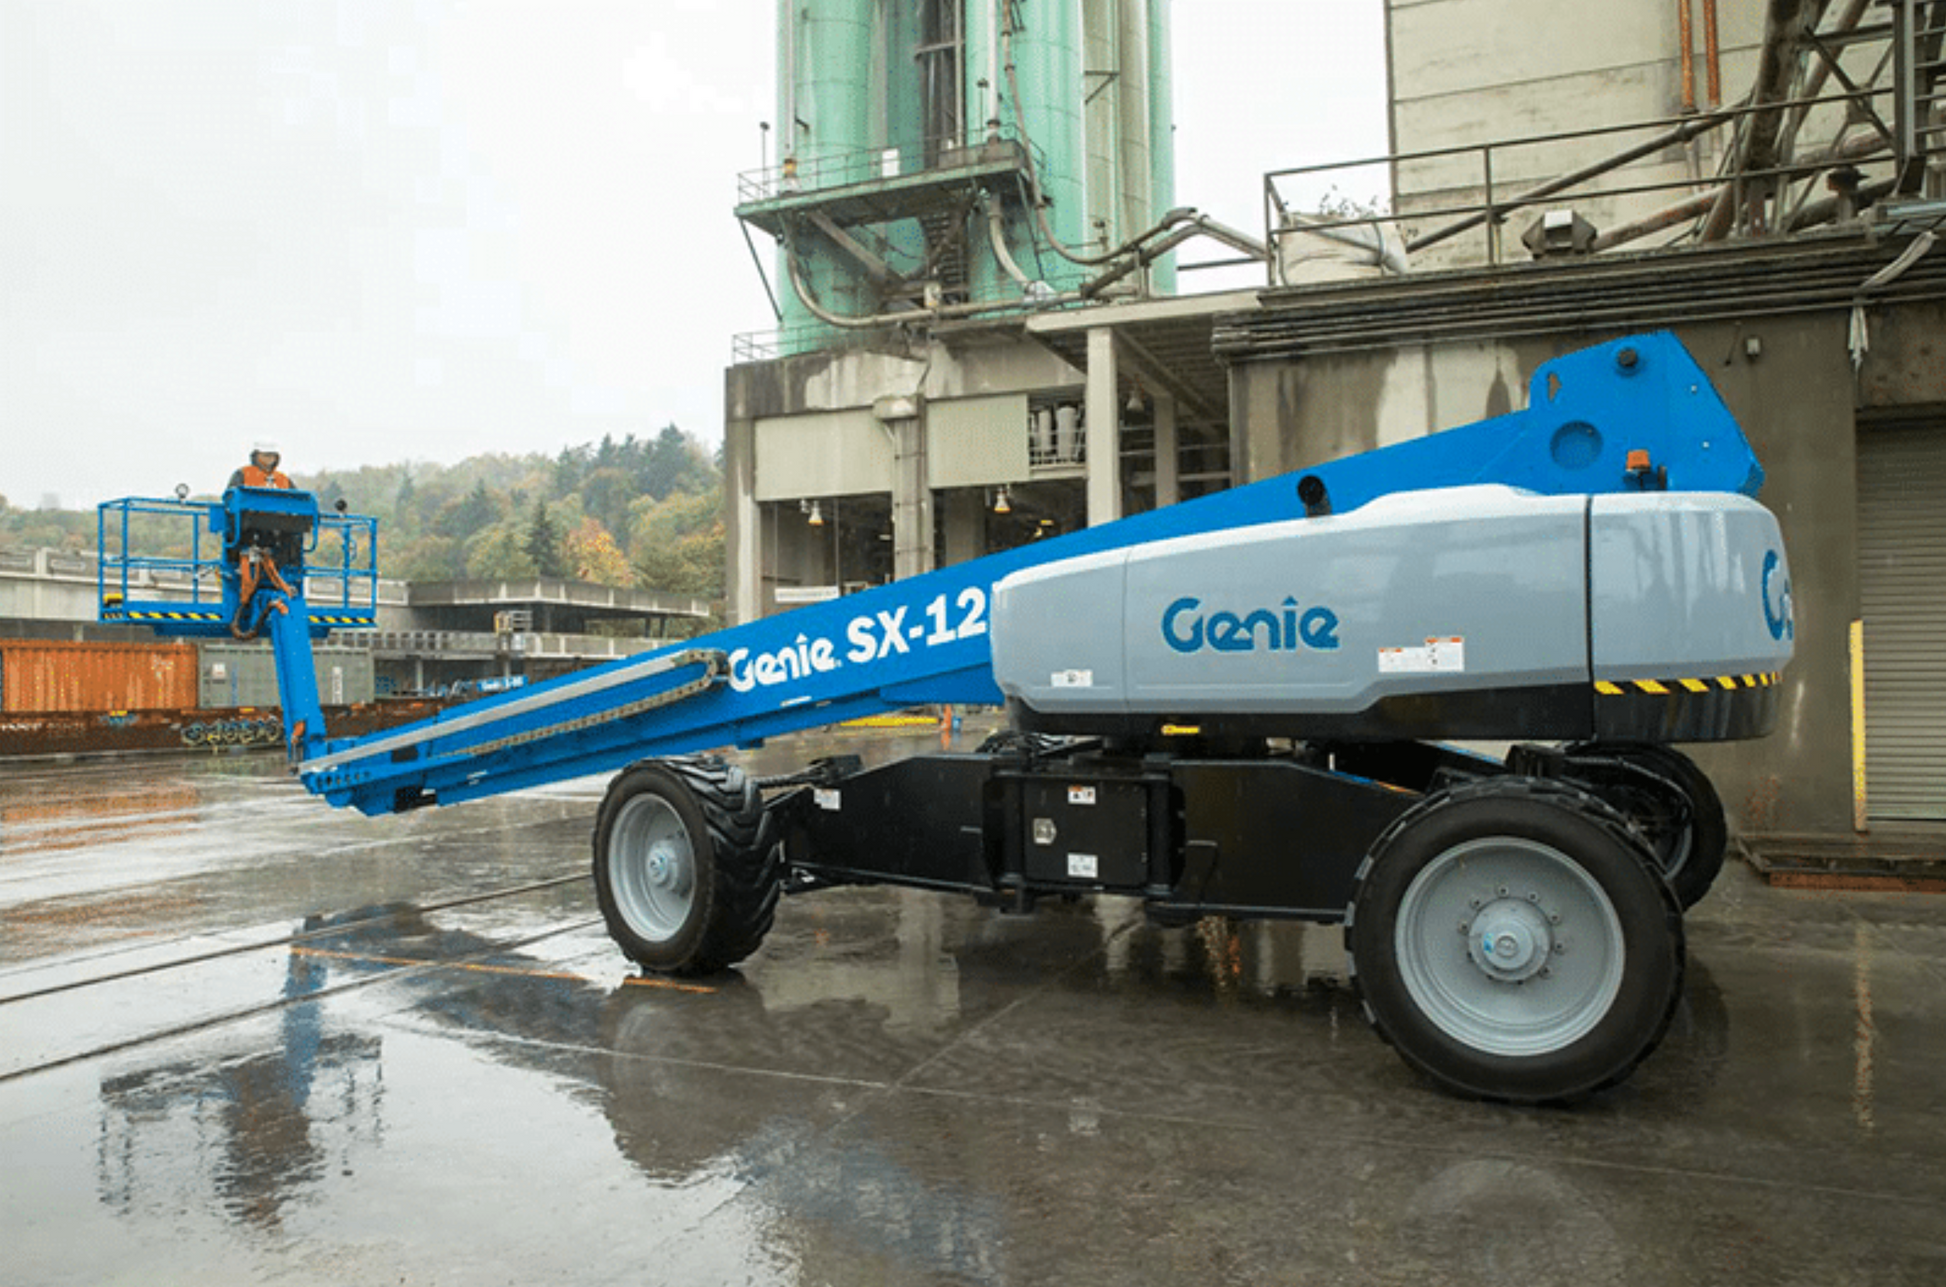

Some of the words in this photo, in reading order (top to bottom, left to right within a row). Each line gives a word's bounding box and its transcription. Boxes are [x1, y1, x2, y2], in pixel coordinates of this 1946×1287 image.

[727, 632, 838, 693] Genie
[846, 586, 988, 664] SX-12
[1161, 595, 1340, 653] Genie
